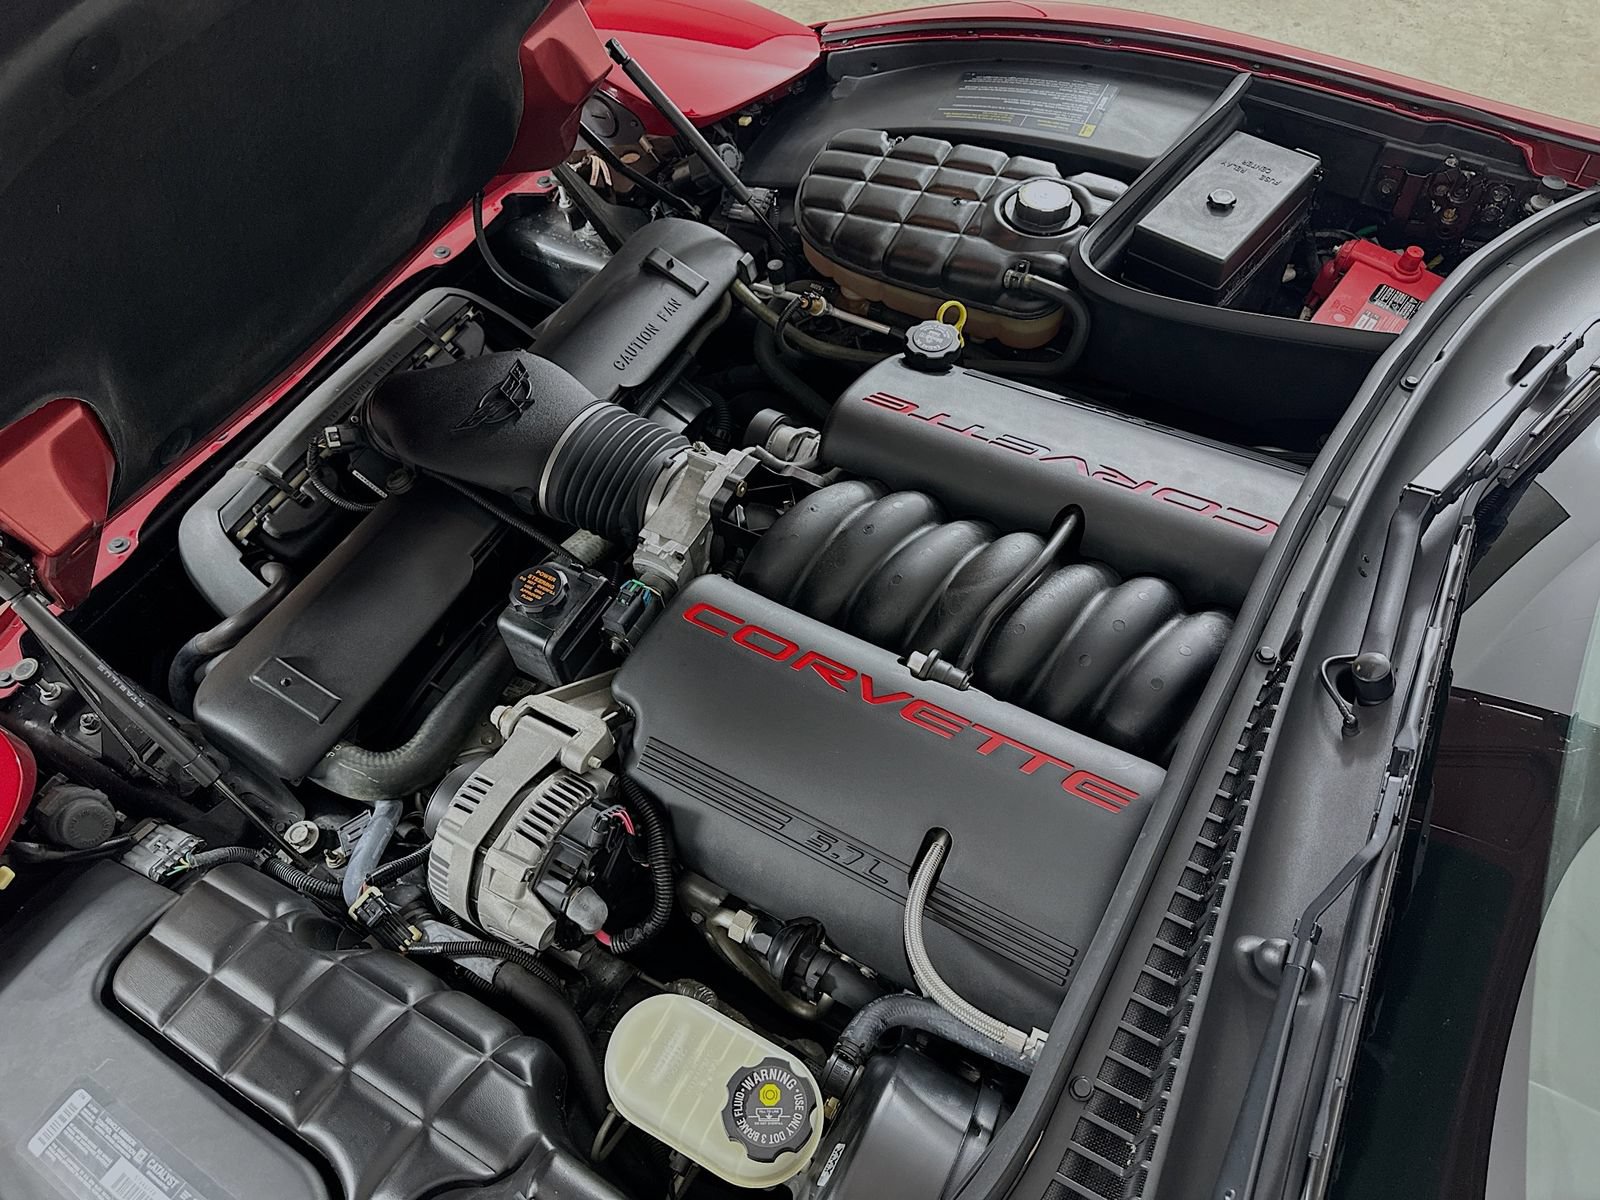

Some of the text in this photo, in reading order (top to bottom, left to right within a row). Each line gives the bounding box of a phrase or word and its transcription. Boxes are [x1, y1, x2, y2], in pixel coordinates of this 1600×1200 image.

[1219, 160, 1282, 186] FUSE RELAY
[1241, 160, 1272, 174] CENTER
[612, 297, 683, 371] CAUTION FAN
[862, 391, 1280, 535] CORVETTE
[527, 574, 555, 590] STEERING
[535, 569, 557, 583] POWER
[97, 664, 145, 708] STABILUS
[682, 602, 1141, 814] CORVETTE
[804, 830, 889, 865] 5.7L
[741, 1068, 797, 1090] WARNING
[733, 1091, 804, 1145] USE ONLY DOT 3 BRAKE FLUID
[146, 1158, 180, 1189] CATALYST
